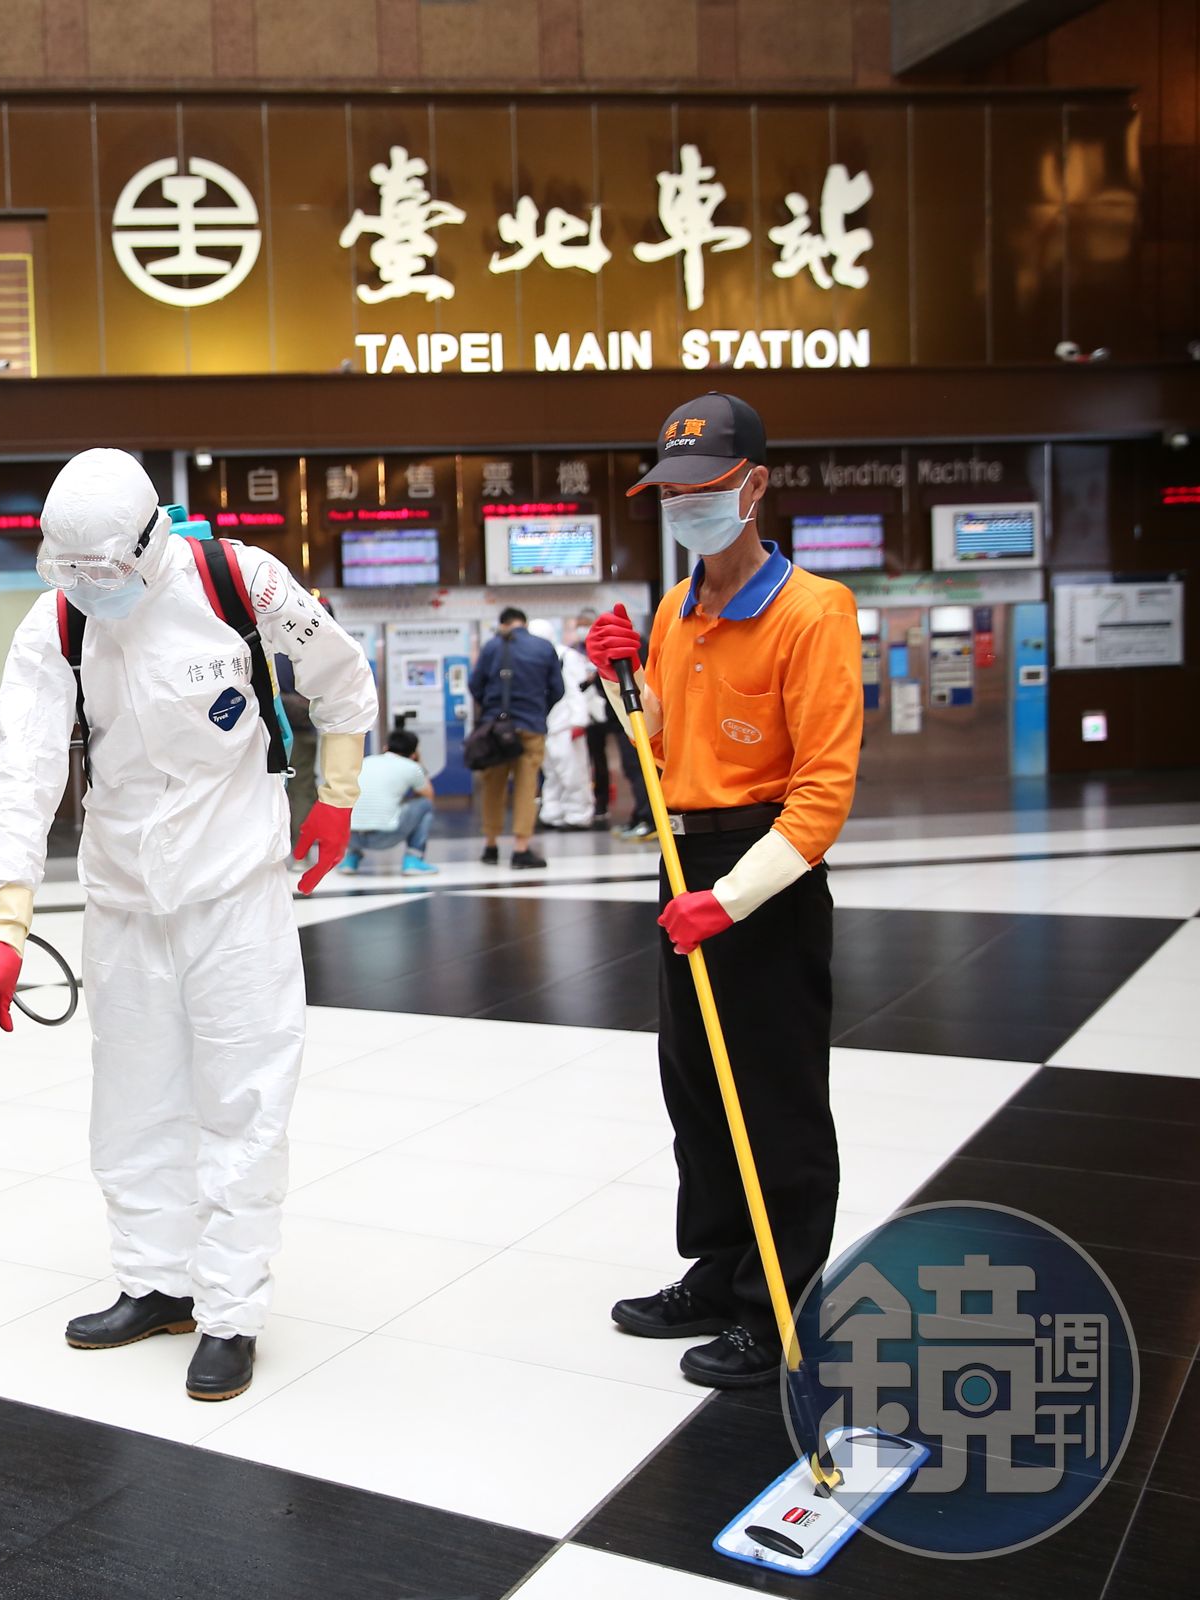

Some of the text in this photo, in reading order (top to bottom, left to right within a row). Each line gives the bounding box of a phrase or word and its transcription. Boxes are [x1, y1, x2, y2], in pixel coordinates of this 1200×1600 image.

[339, 145, 874, 311] 臺北車站
[355, 329, 870, 374] TAIPEI MAIN STATION
[247, 460, 591, 502] 自動售票機
[819, 460, 906, 488] Vending
[917, 457, 1003, 485] Machine
